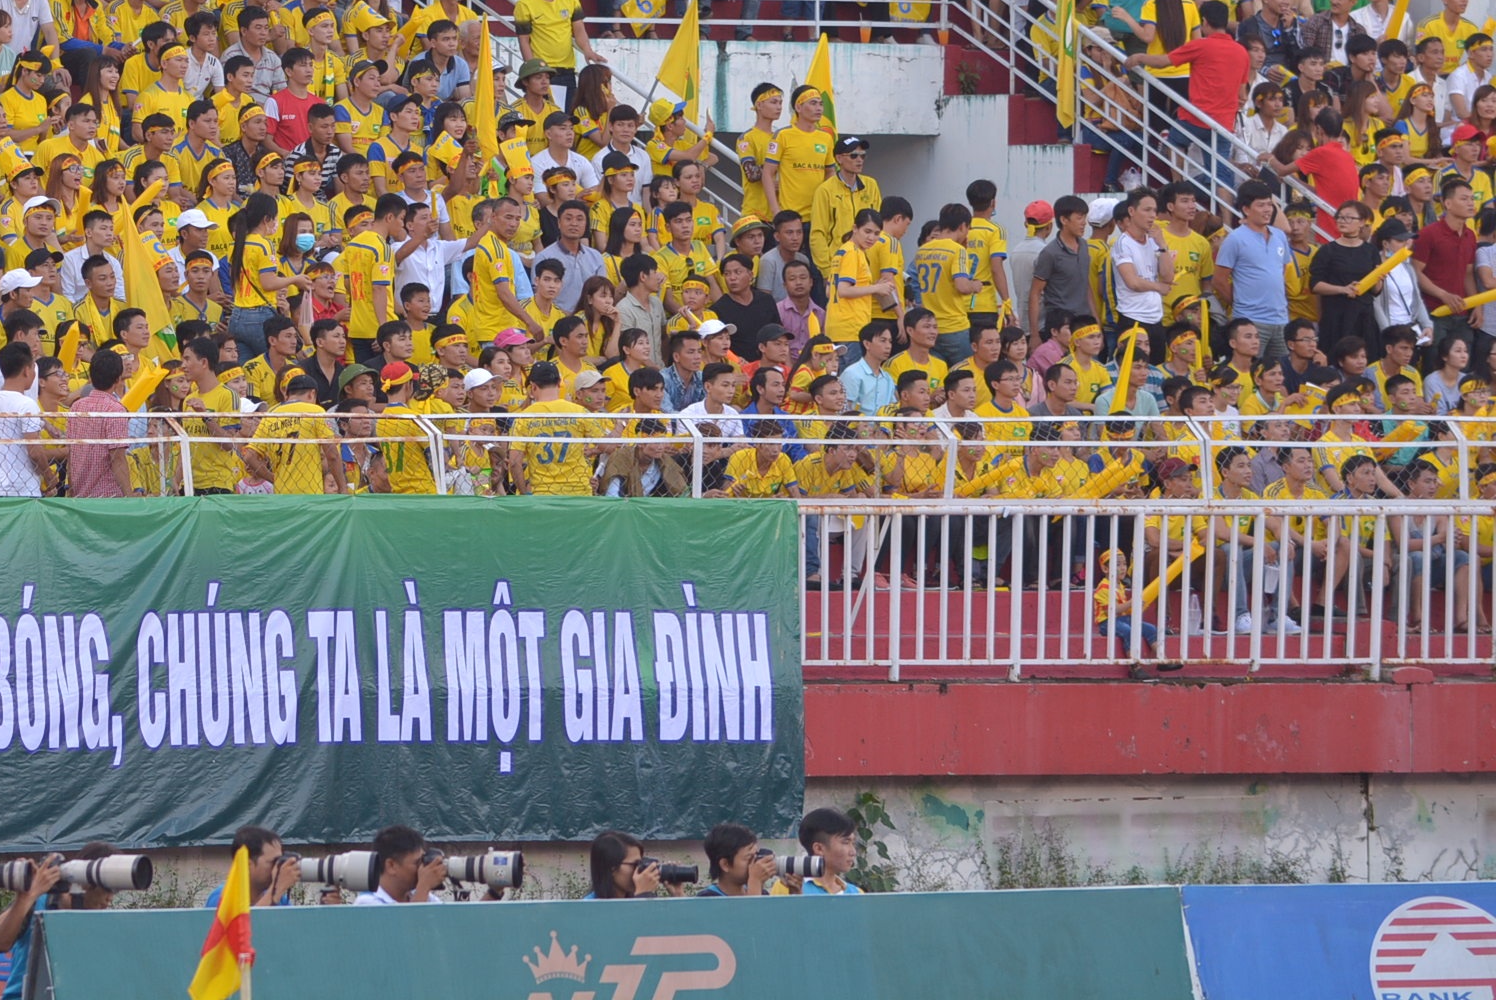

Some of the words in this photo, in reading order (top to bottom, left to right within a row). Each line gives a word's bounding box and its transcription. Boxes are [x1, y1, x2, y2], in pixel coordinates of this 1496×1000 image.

[918, 263, 942, 294] 37
[536, 430, 572, 465] 37
[137, 580, 298, 749] CHÚNG
[307, 609, 363, 743] TA
[375, 579, 432, 743] LÀ
[443, 579, 545, 774] MỘT
[559, 609, 644, 743] GIA
[653, 581, 774, 743] ĐÌNH
